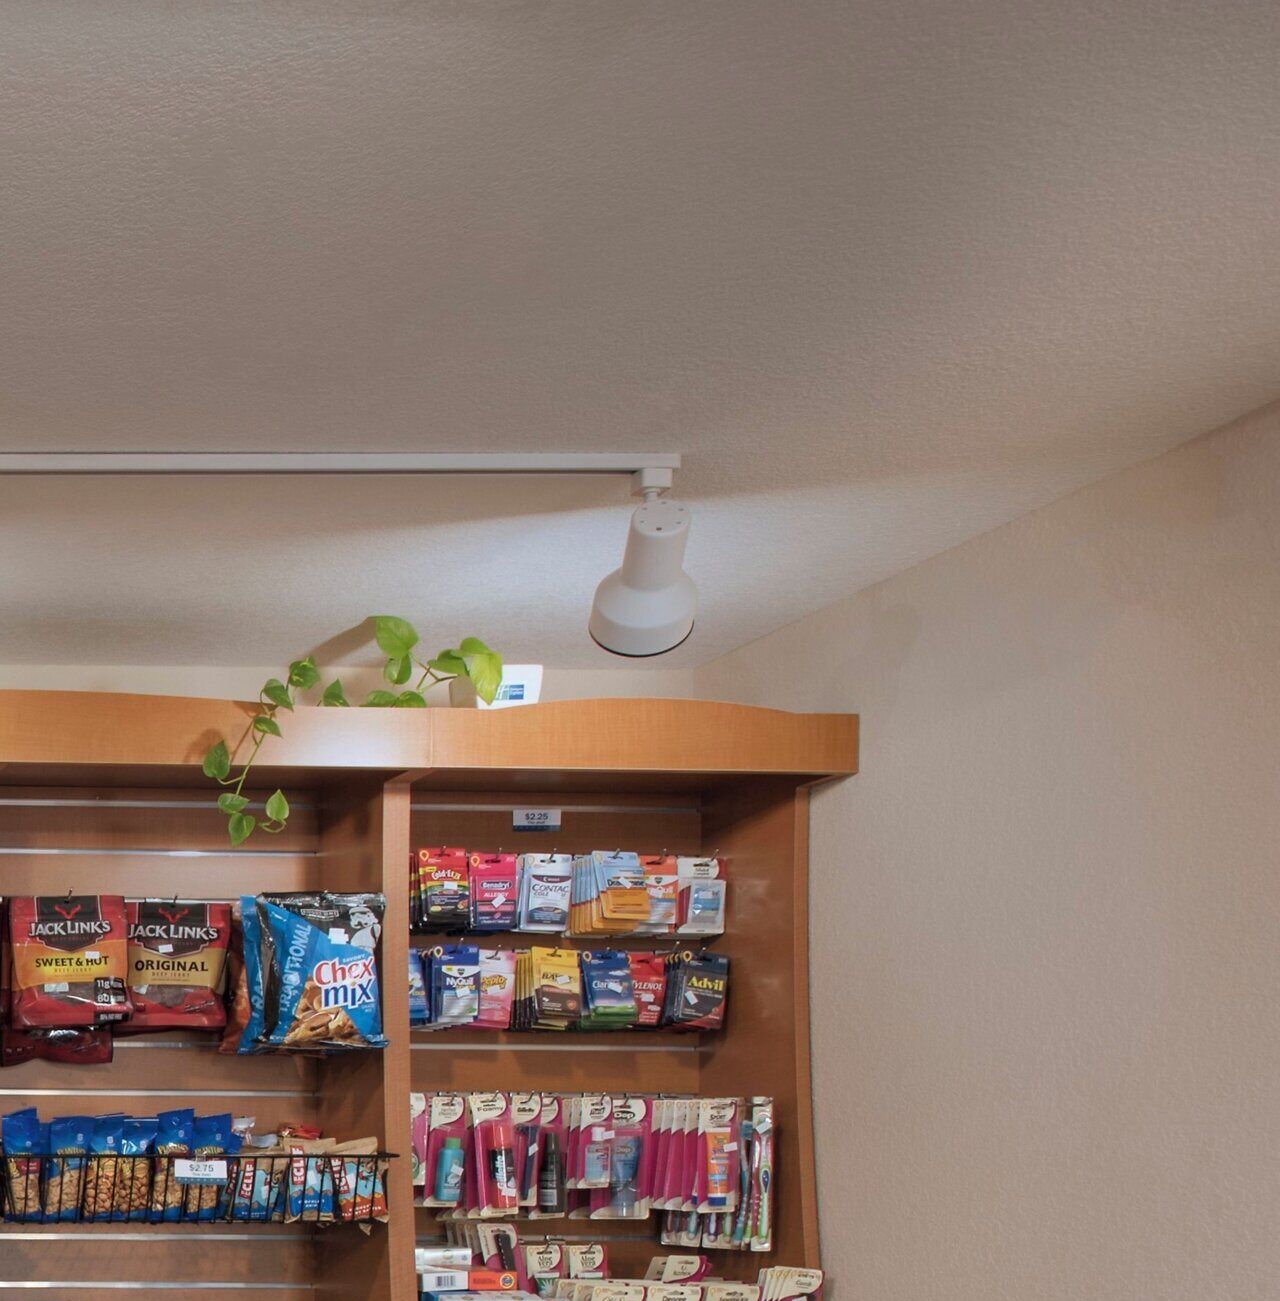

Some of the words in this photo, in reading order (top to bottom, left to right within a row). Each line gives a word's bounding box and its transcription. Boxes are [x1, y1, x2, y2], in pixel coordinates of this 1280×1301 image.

[525, 812, 549, 821] $2.25
[29, 921, 66, 937] JACK
[66, 920, 111, 935] LINK'S
[128, 924, 169, 939] JACK
[169, 924, 218, 940] LINK'S
[35, 957, 74, 968] SWEET
[134, 959, 209, 972] ORIGINAL
[314, 956, 375, 986] Chex
[445, 977, 474, 988] NyQuil
[688, 975, 724, 991] Advil
[188, 1165, 214, 1173] $2.75
